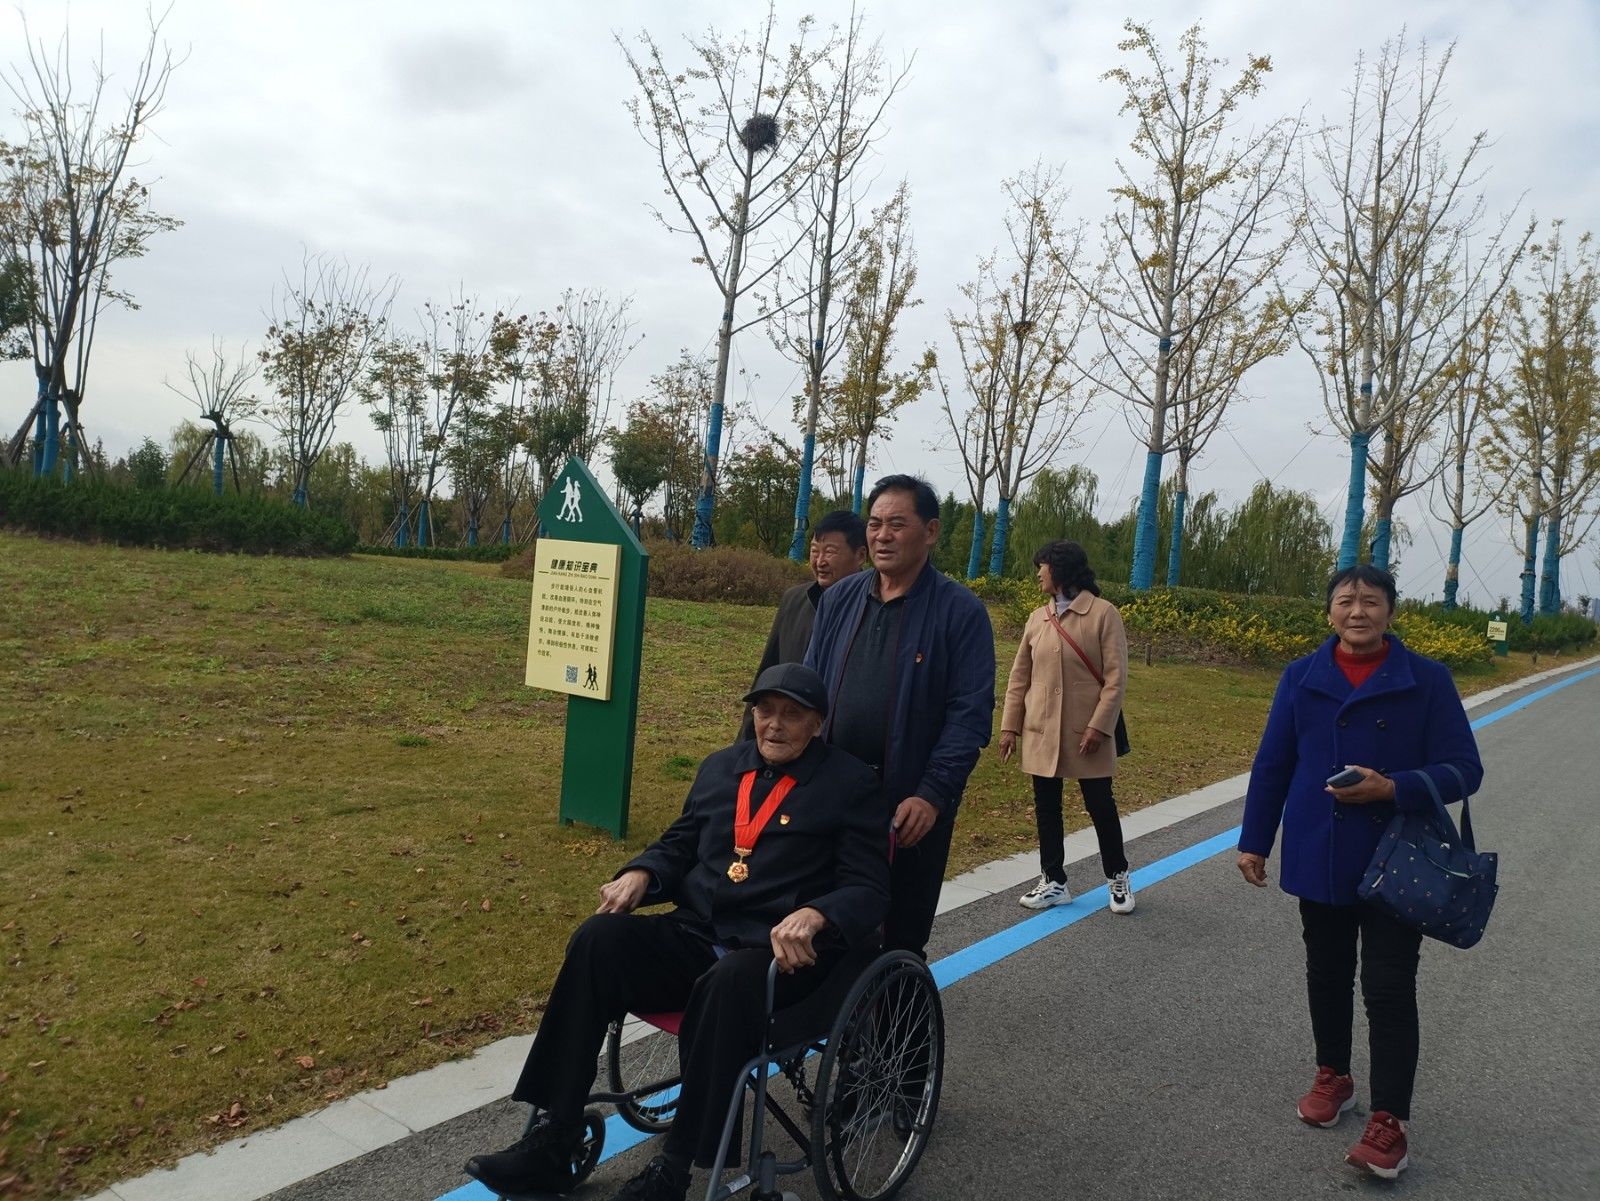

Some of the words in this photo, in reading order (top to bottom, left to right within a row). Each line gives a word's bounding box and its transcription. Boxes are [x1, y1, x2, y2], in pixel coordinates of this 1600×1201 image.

[551, 559, 598, 573] 健康知识宝典
